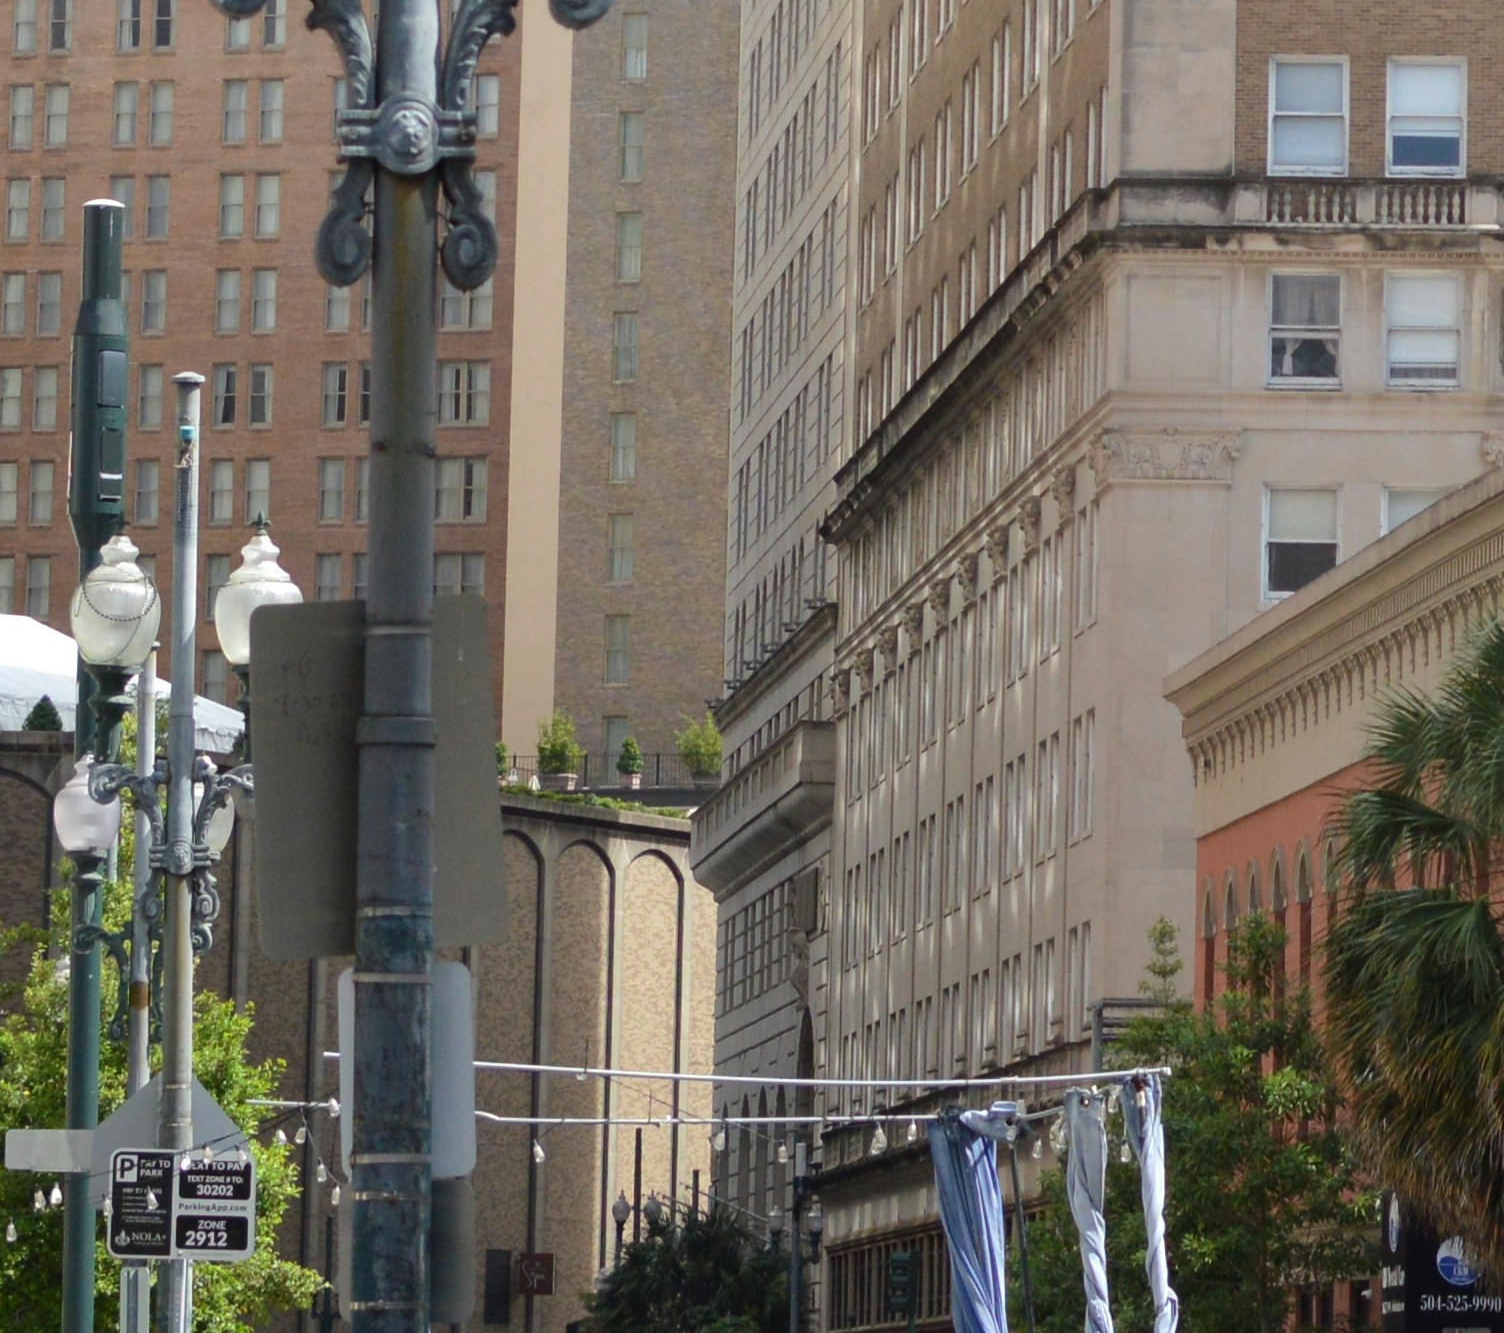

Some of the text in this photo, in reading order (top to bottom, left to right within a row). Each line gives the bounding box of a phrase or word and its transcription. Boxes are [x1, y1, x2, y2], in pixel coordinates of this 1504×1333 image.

[159, 1160, 171, 1169] TO
[211, 1162, 226, 1171] TO
[227, 1162, 245, 1171] PAY
[139, 1169, 163, 1177] PARK
[187, 1175, 205, 1183] TEXT
[196, 1184, 234, 1197] 30202
[198, 1220, 227, 1230] ZONE
[185, 1230, 228, 1247] 2912
[1420, 1294, 1502, 1313] 504-525-9990
